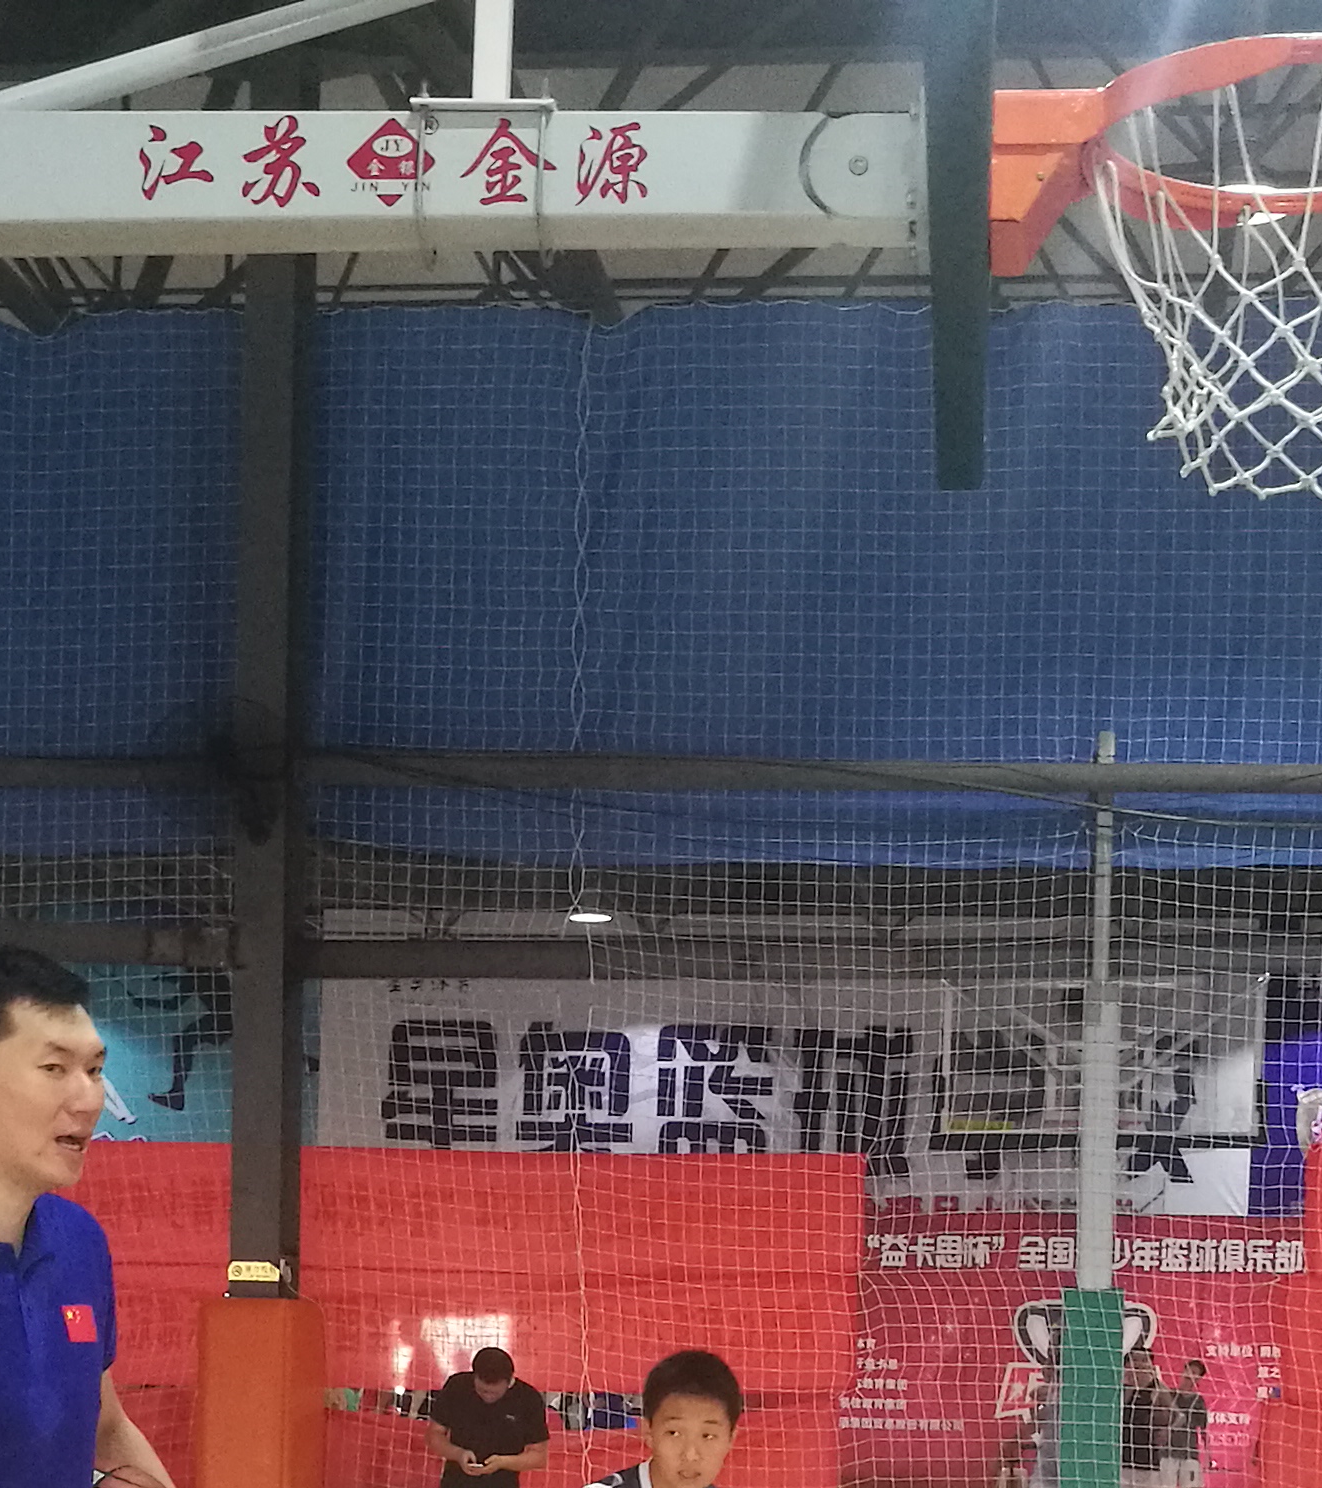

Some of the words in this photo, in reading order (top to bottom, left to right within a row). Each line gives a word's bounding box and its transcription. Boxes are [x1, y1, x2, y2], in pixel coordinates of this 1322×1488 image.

[380, 139, 404, 151] JY
[139, 114, 320, 207] 江苏
[459, 118, 649, 206] 金源
[350, 182, 378, 192] JIN
[1019, 1236, 1305, 1273] 全国少年篮球俱乐部
